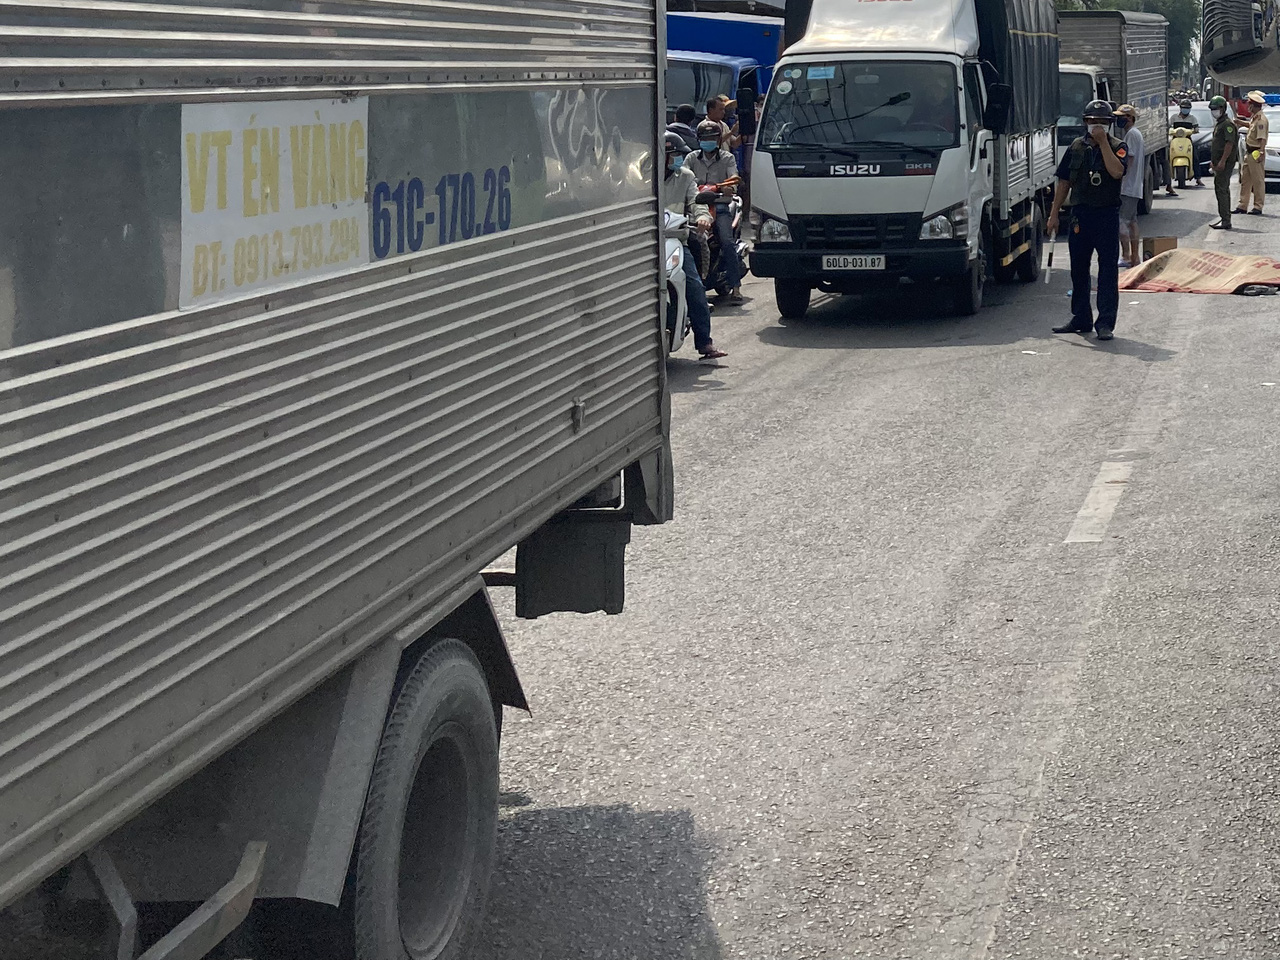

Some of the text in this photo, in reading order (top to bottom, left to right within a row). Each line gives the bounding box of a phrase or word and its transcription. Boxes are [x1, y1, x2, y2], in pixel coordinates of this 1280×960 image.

[185, 111, 366, 217] VT ÉN VÀNG
[830, 165, 881, 175] ISUZU
[373, 166, 511, 259] 61C-170.26
[826, 257, 882, 268] 60LD-031.87
